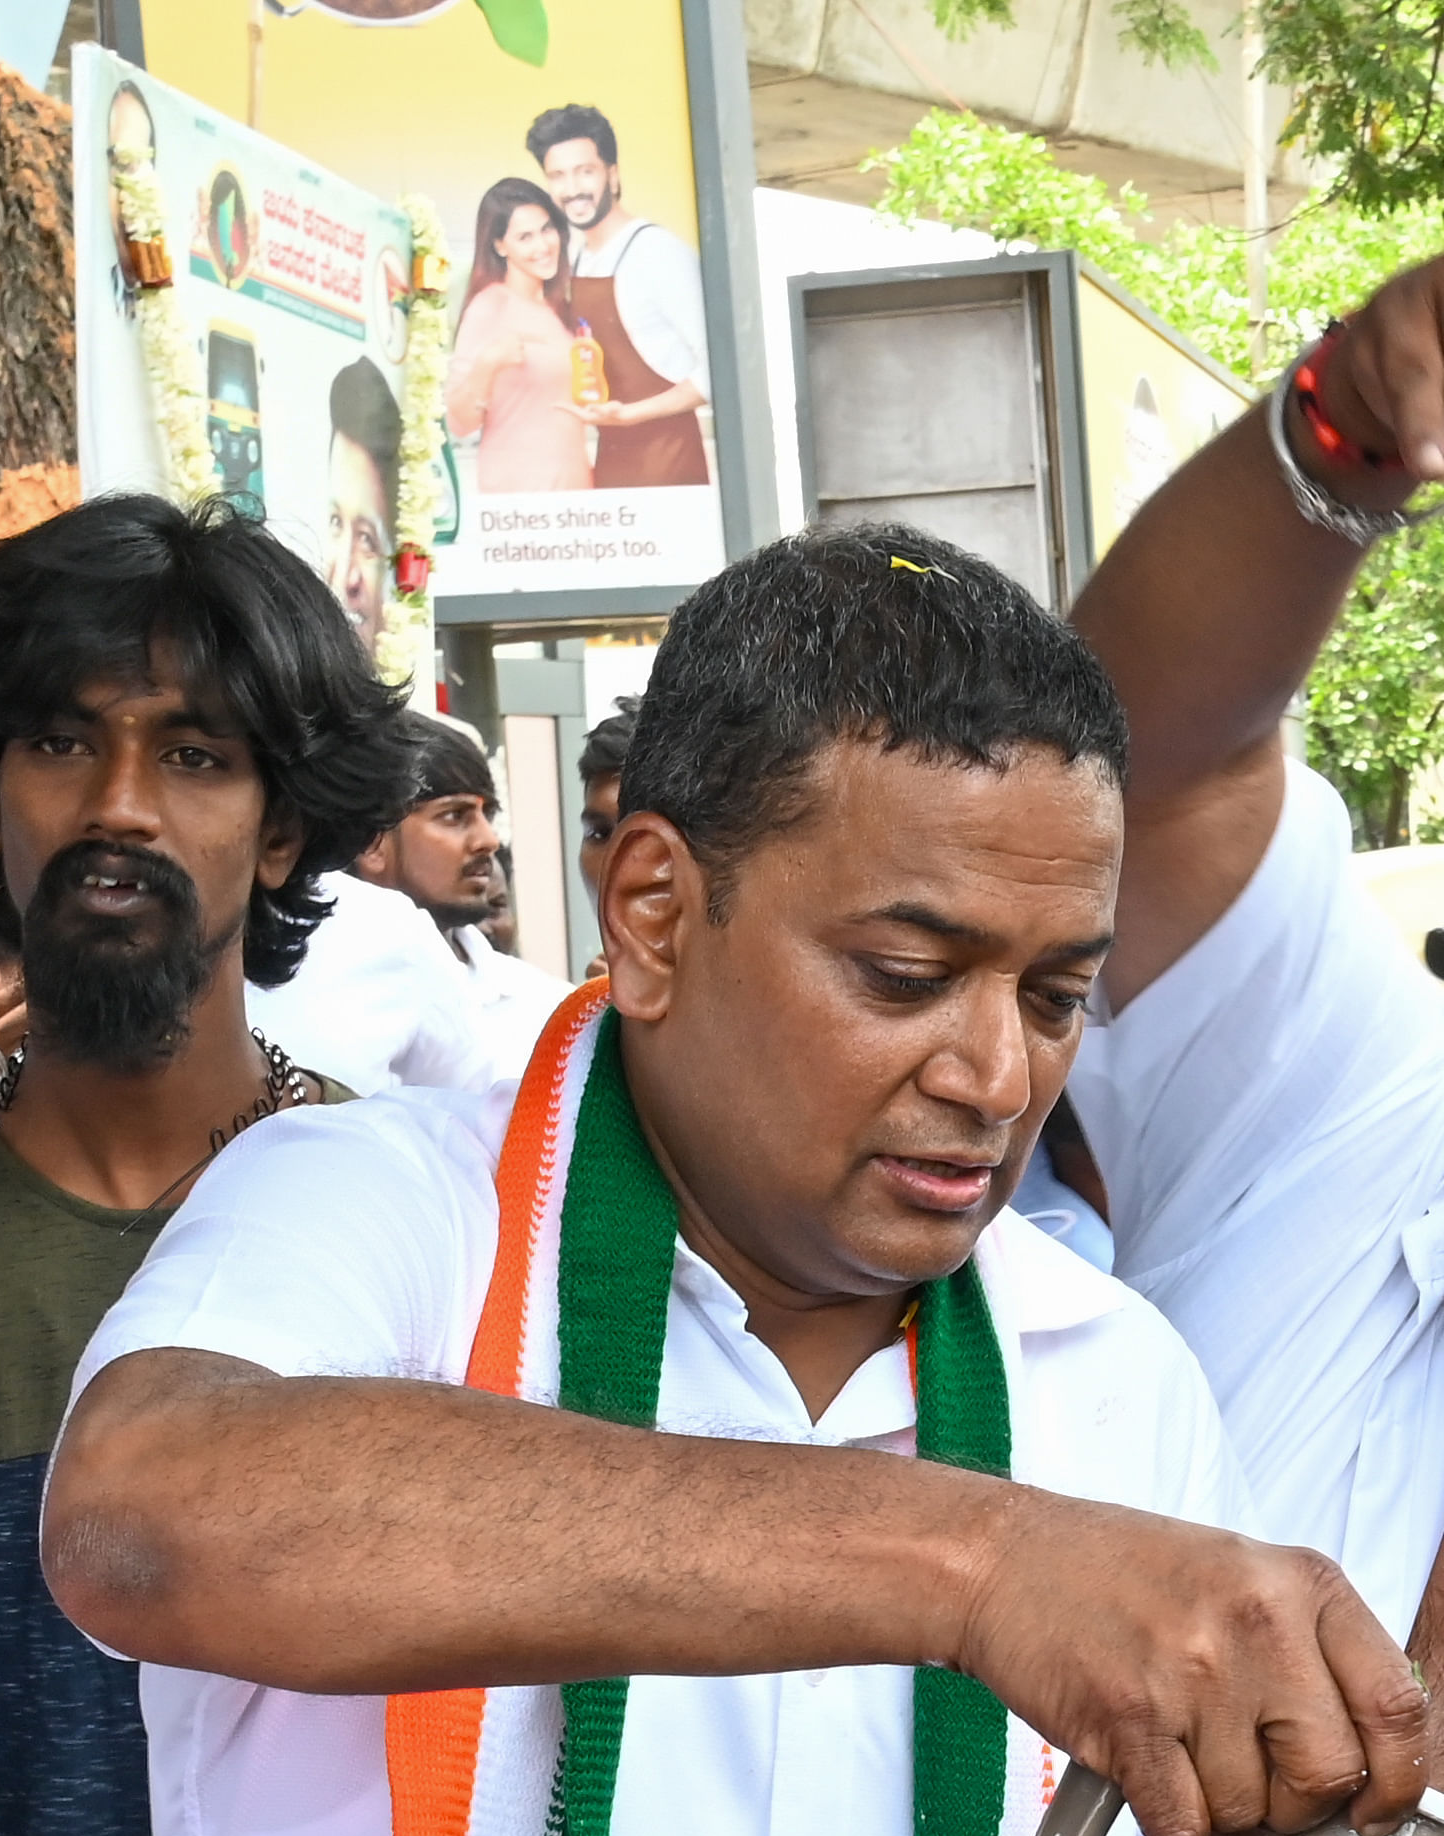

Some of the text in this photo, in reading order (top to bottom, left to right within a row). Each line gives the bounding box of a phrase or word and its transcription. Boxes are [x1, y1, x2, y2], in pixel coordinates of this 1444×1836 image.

[480, 505, 637, 532] Dishes shine &
[483, 538, 663, 563] relationships too.
